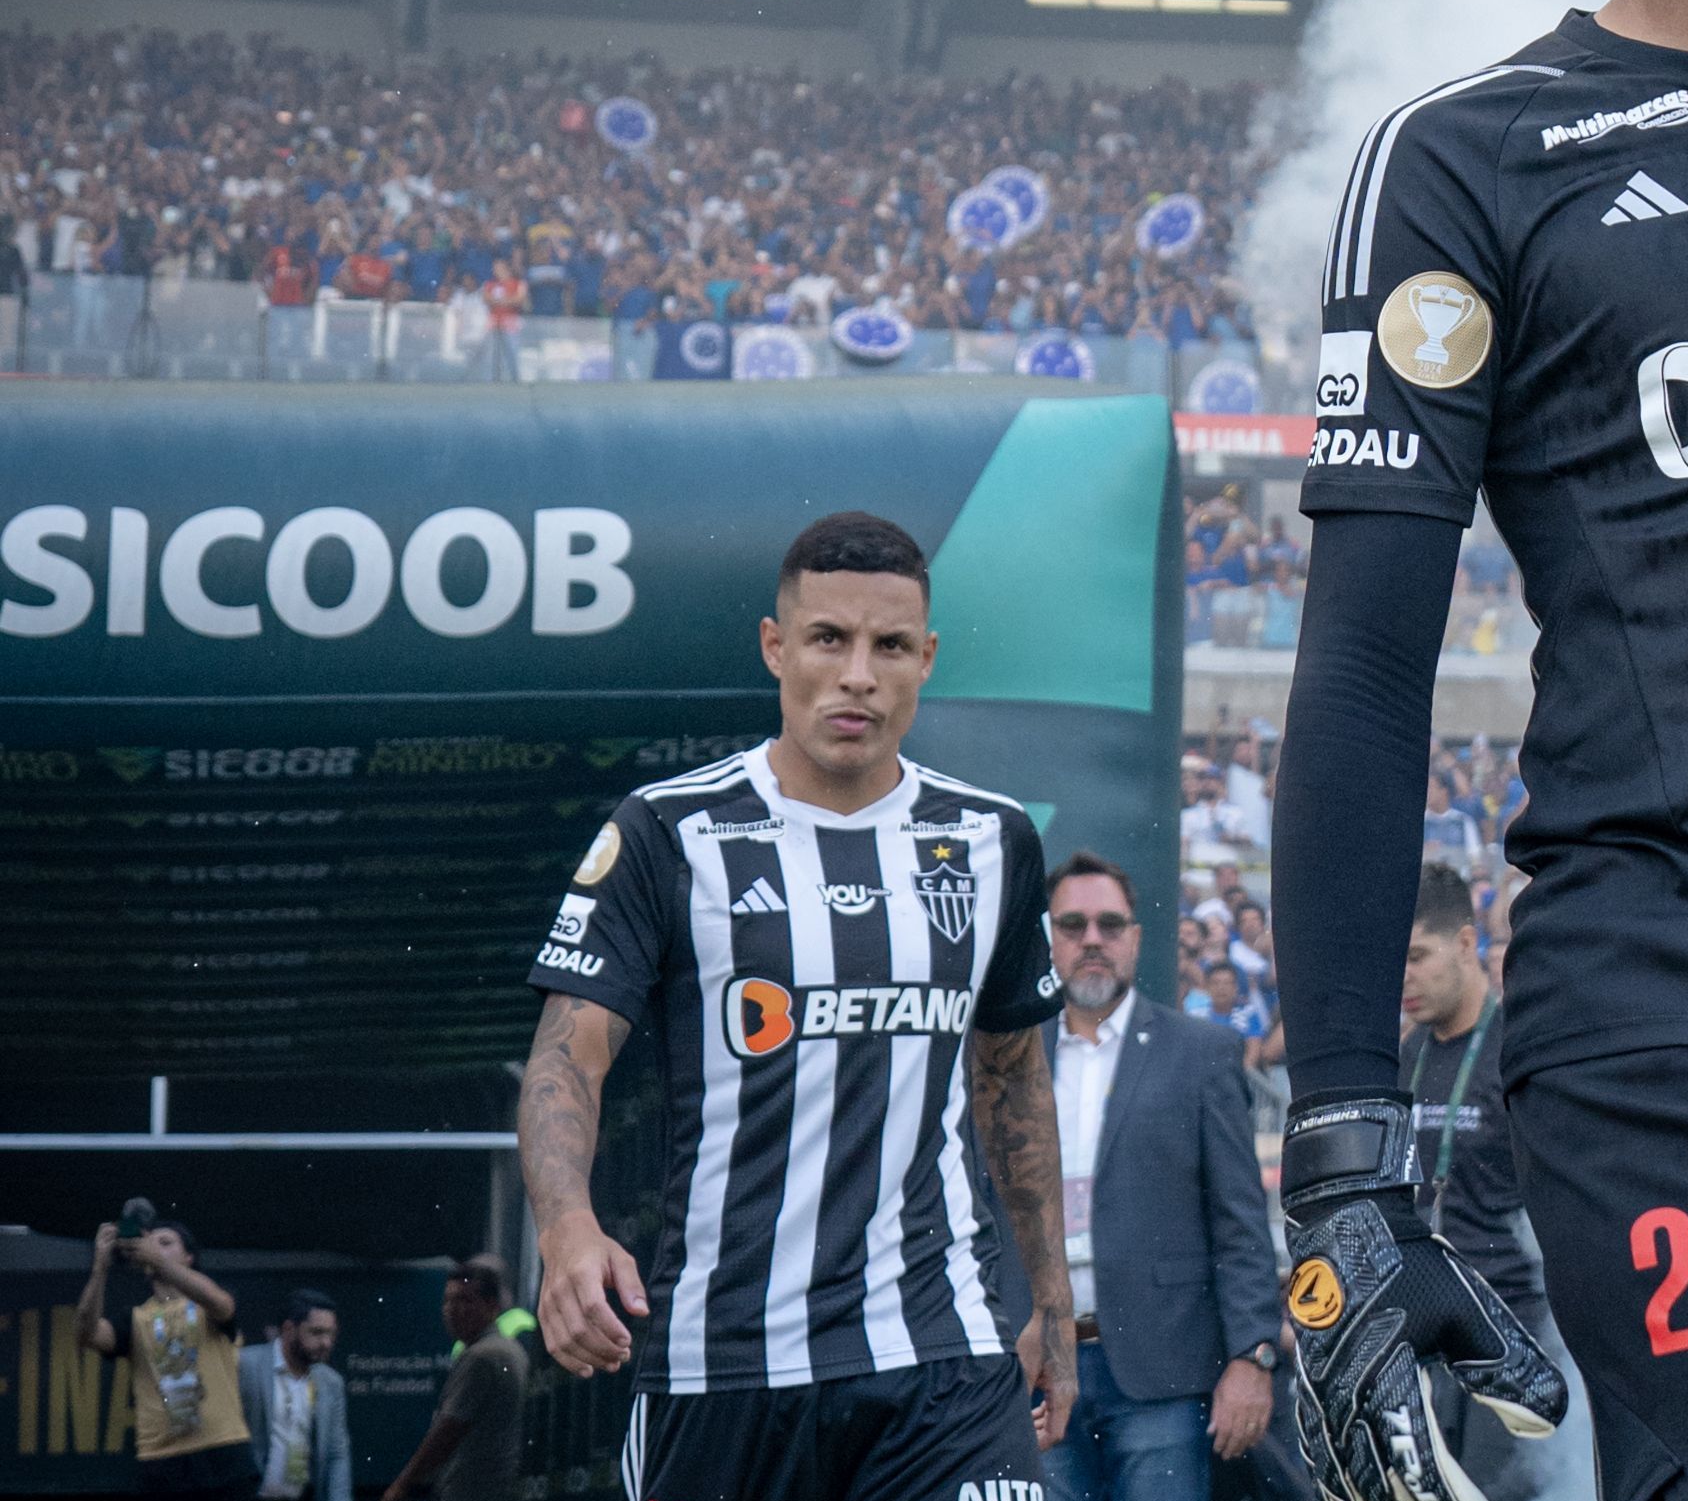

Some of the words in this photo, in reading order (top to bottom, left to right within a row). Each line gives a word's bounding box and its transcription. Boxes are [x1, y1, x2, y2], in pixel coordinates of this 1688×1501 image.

[0, 503, 635, 639] SICOOB
[697, 817, 786, 836] Multimarcas
[817, 883, 867, 905] YOU
[921, 877, 972, 893] CAM
[802, 987, 973, 1036] BETANO
